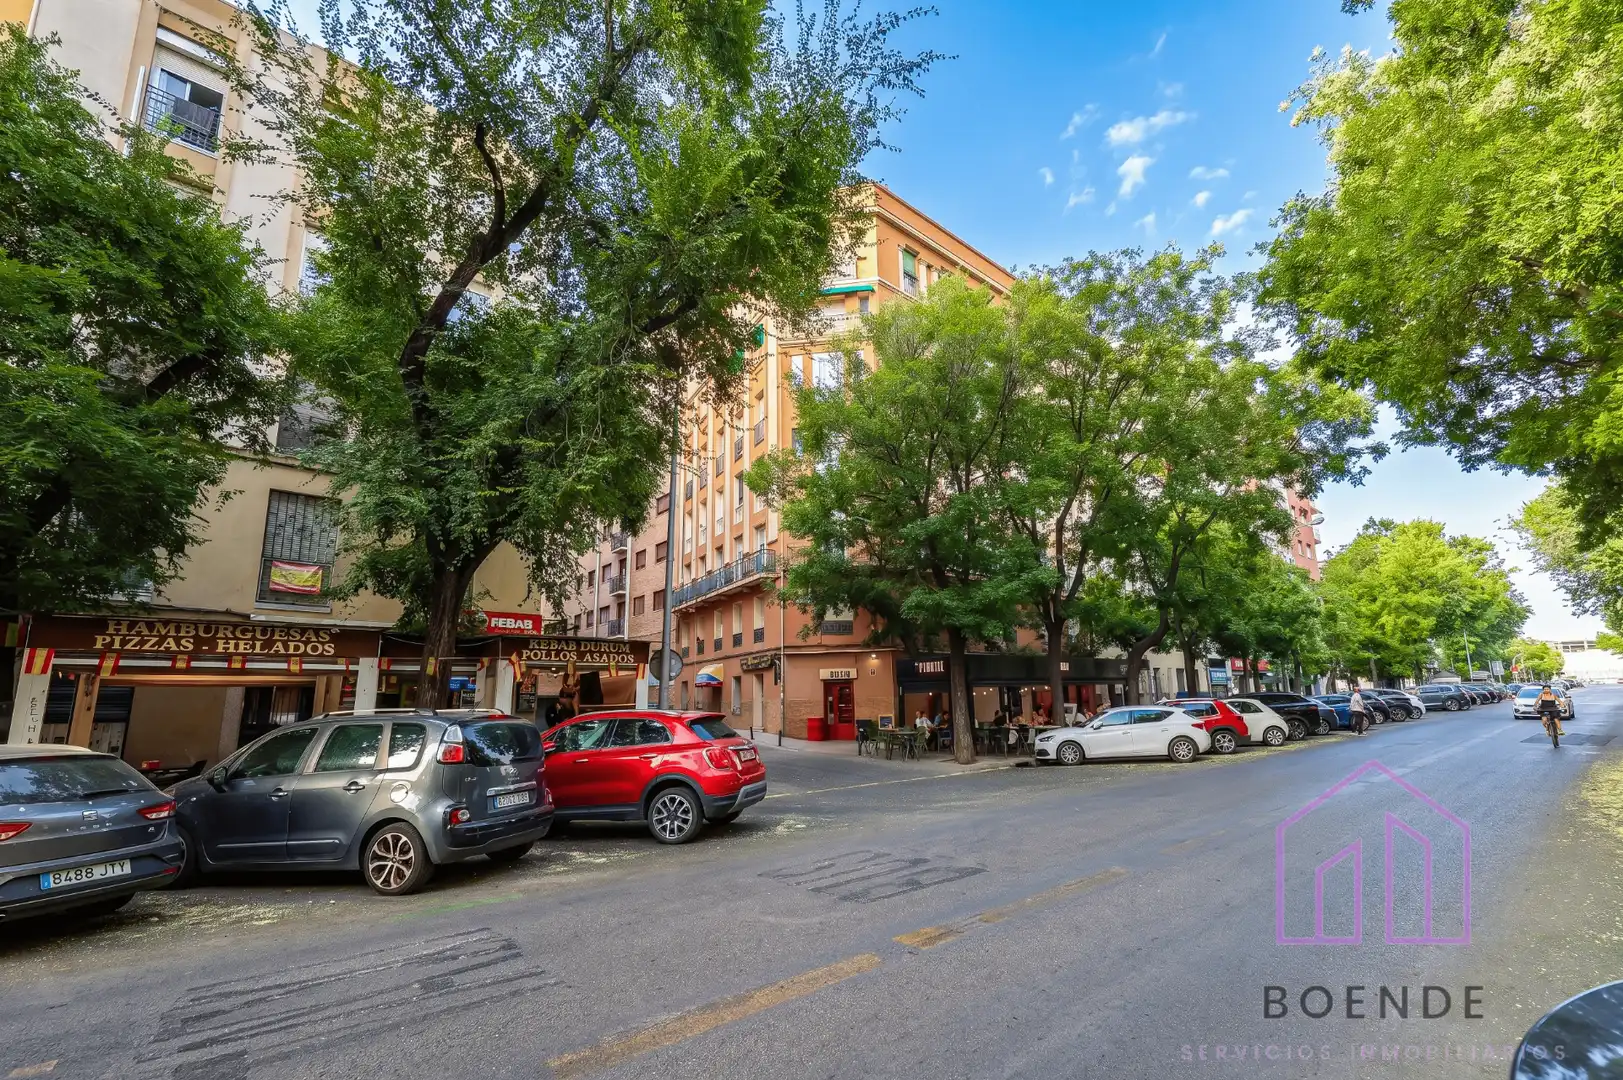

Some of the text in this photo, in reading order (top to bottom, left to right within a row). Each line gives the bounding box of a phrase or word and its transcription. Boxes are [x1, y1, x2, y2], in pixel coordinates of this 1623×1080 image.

[105, 620, 331, 642] HAMBURGUESAS
[93, 635, 194, 652] PIZZAS
[216, 639, 335, 656] HELADOS
[528, 639, 630, 653] KEBAB DURUM
[521, 650, 634, 664] POLLOS ASADOS
[53, 861, 126, 884] 8488 JTY
